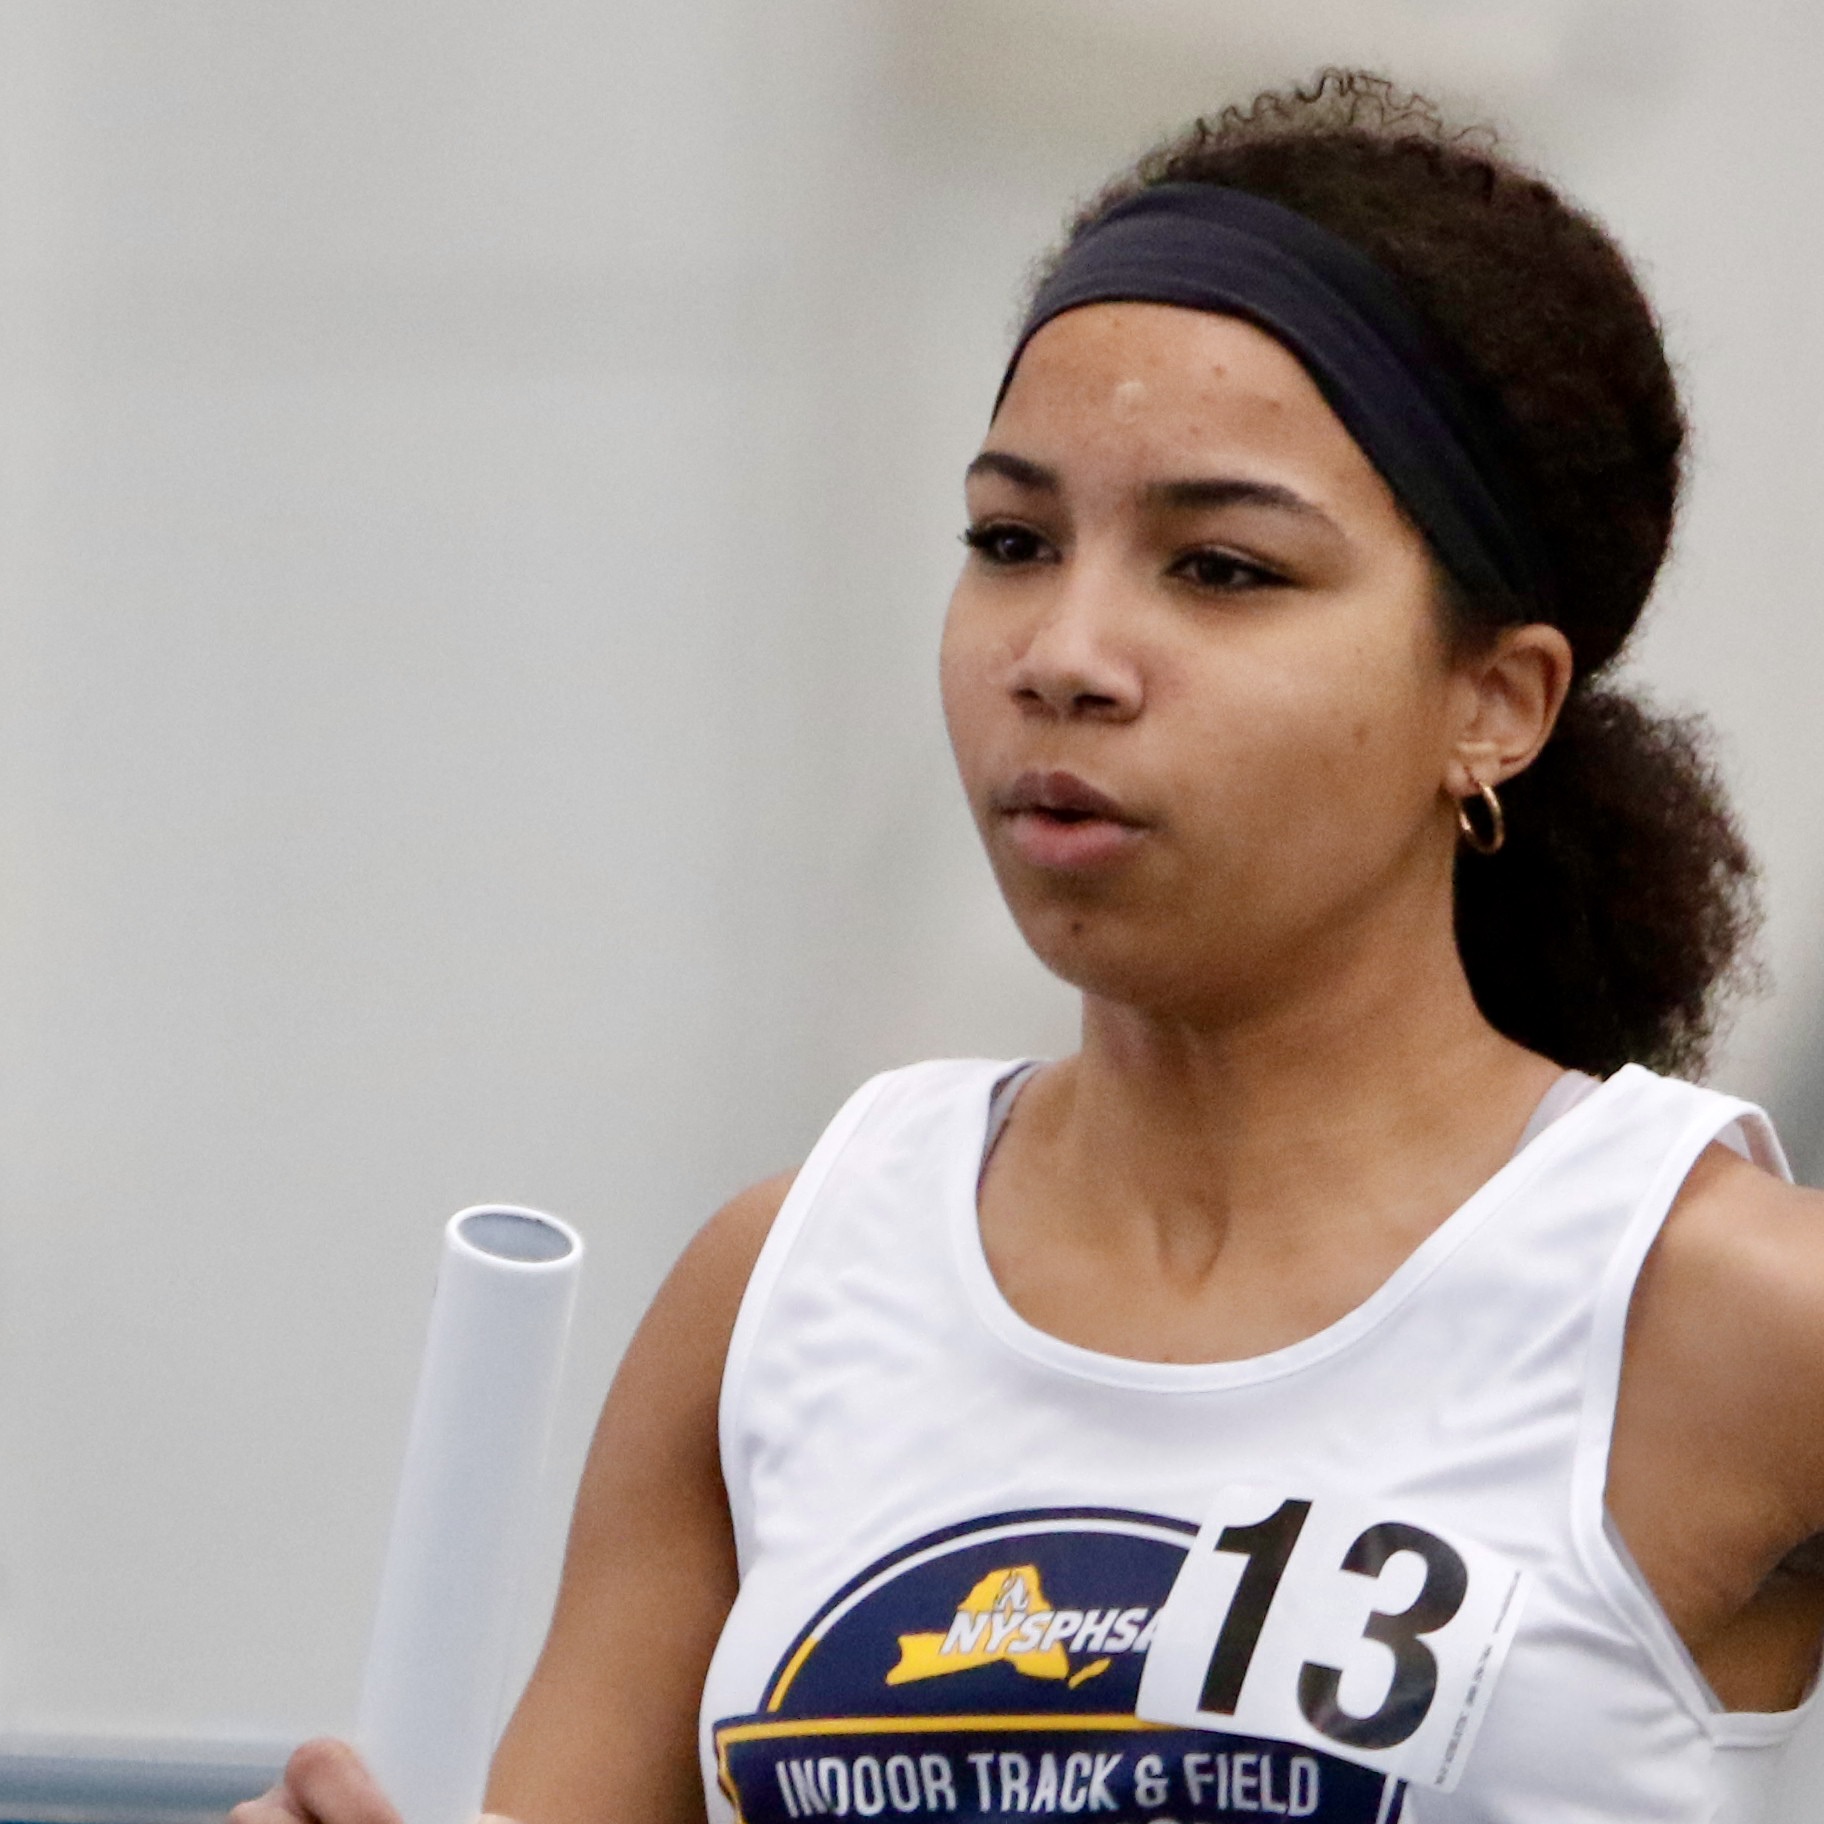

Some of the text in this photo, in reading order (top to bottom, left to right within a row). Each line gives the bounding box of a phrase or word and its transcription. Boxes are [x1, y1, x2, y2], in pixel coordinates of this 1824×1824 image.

[1197, 1498, 1469, 1751] 13
[776, 1751, 1320, 1818] INDOOR TRACK & FIELD
